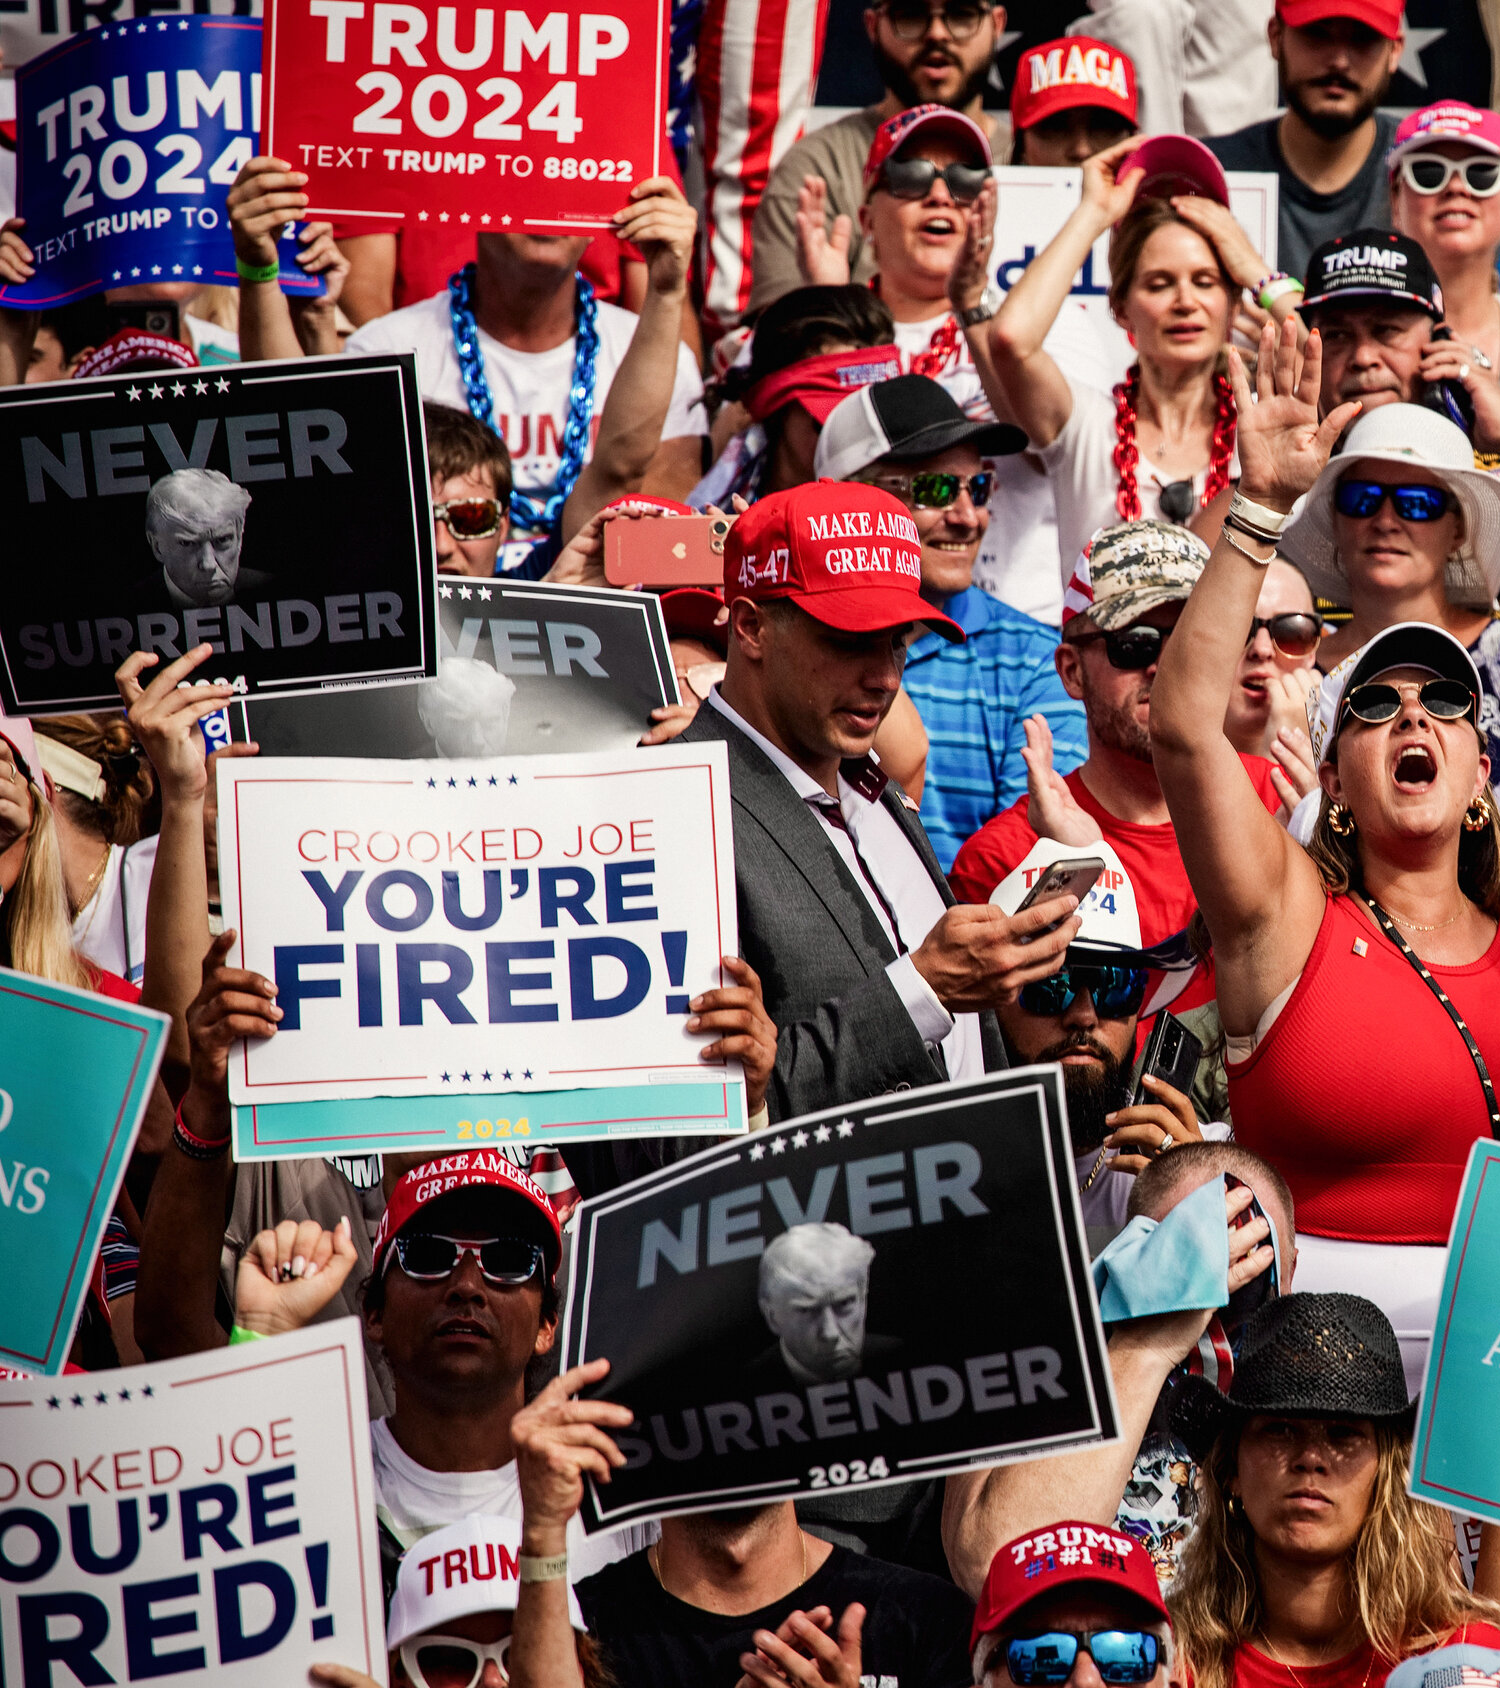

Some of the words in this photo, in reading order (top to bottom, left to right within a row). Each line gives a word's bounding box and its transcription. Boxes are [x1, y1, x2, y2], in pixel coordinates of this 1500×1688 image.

[310, 2, 630, 76] TRUMP
[1029, 45, 1128, 97] MAGA
[353, 70, 583, 143] 2024
[62, 134, 252, 218] 2024
[299, 144, 373, 169] TEXT
[383, 149, 486, 176] TRUMP
[496, 154, 533, 178] TO
[543, 157, 634, 183] 88022
[35, 229, 77, 264] TEXT
[83, 207, 172, 242] TRUMP
[181, 207, 219, 230] TO
[1323, 246, 1408, 273] TRUMP
[116, 336, 195, 365] AMERICA
[20, 408, 353, 503] NEVER
[807, 512, 873, 541] MAKE
[1112, 534, 1201, 562] TRUMP
[737, 548, 790, 589] 45-47
[825, 547, 892, 575] GREAT
[20, 590, 405, 670] SURRENDER
[440, 617, 610, 678] VER
[298, 827, 544, 866] CROOKED
[564, 819, 656, 856] JOE
[301, 859, 659, 933] YOU'RE
[274, 930, 692, 1031] FIRED!
[457, 1117, 532, 1140] 2024
[405, 1153, 469, 1185] MAKE
[471, 1148, 554, 1215] AMERICA
[636, 1140, 991, 1290] NEVER
[616, 1345, 1070, 1471] SURRENDER
[0, 1444, 183, 1499] OKED
[205, 1417, 296, 1474] JOE
[809, 1457, 890, 1489] 2024
[0, 1465, 300, 1583] OU'RE
[1011, 1527, 1133, 1565] TRUMP
[418, 1543, 521, 1597] TRUM
[1025, 1554, 1057, 1580] #1
[1059, 1547, 1093, 1566] #1
[1098, 1551, 1127, 1573] #1
[17, 1541, 335, 1688] RED!
